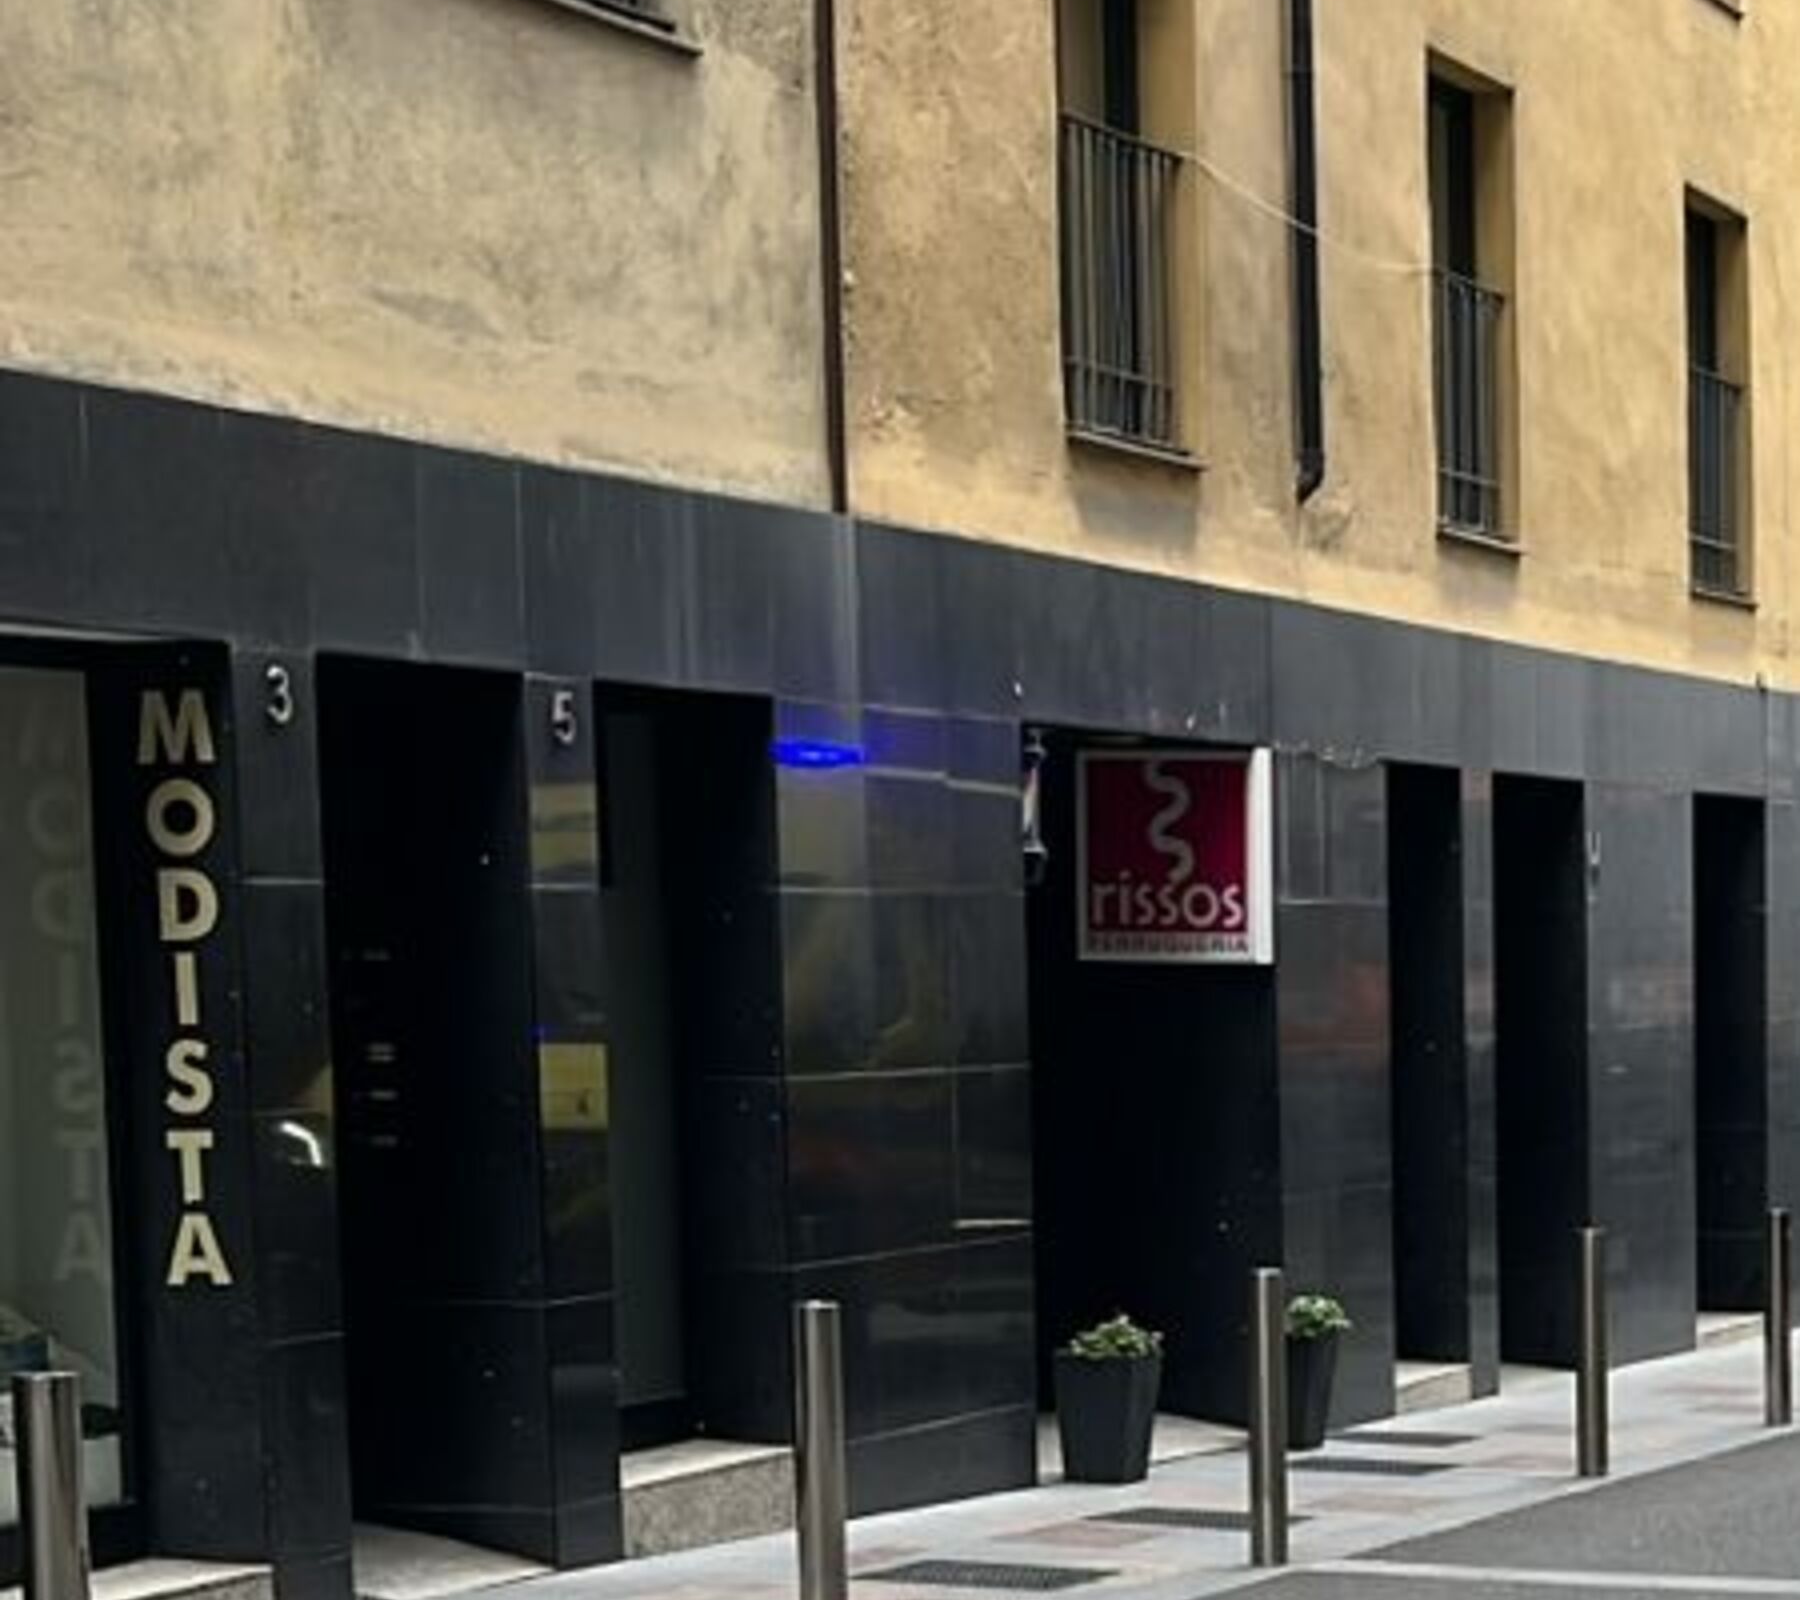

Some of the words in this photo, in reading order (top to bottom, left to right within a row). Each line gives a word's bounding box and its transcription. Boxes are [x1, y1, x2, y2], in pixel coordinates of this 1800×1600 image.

[266, 665, 294, 724] 3
[552, 690, 577, 745] 5
[1091, 869, 1244, 929] rissos
[136, 689, 234, 1287] MODISTA
